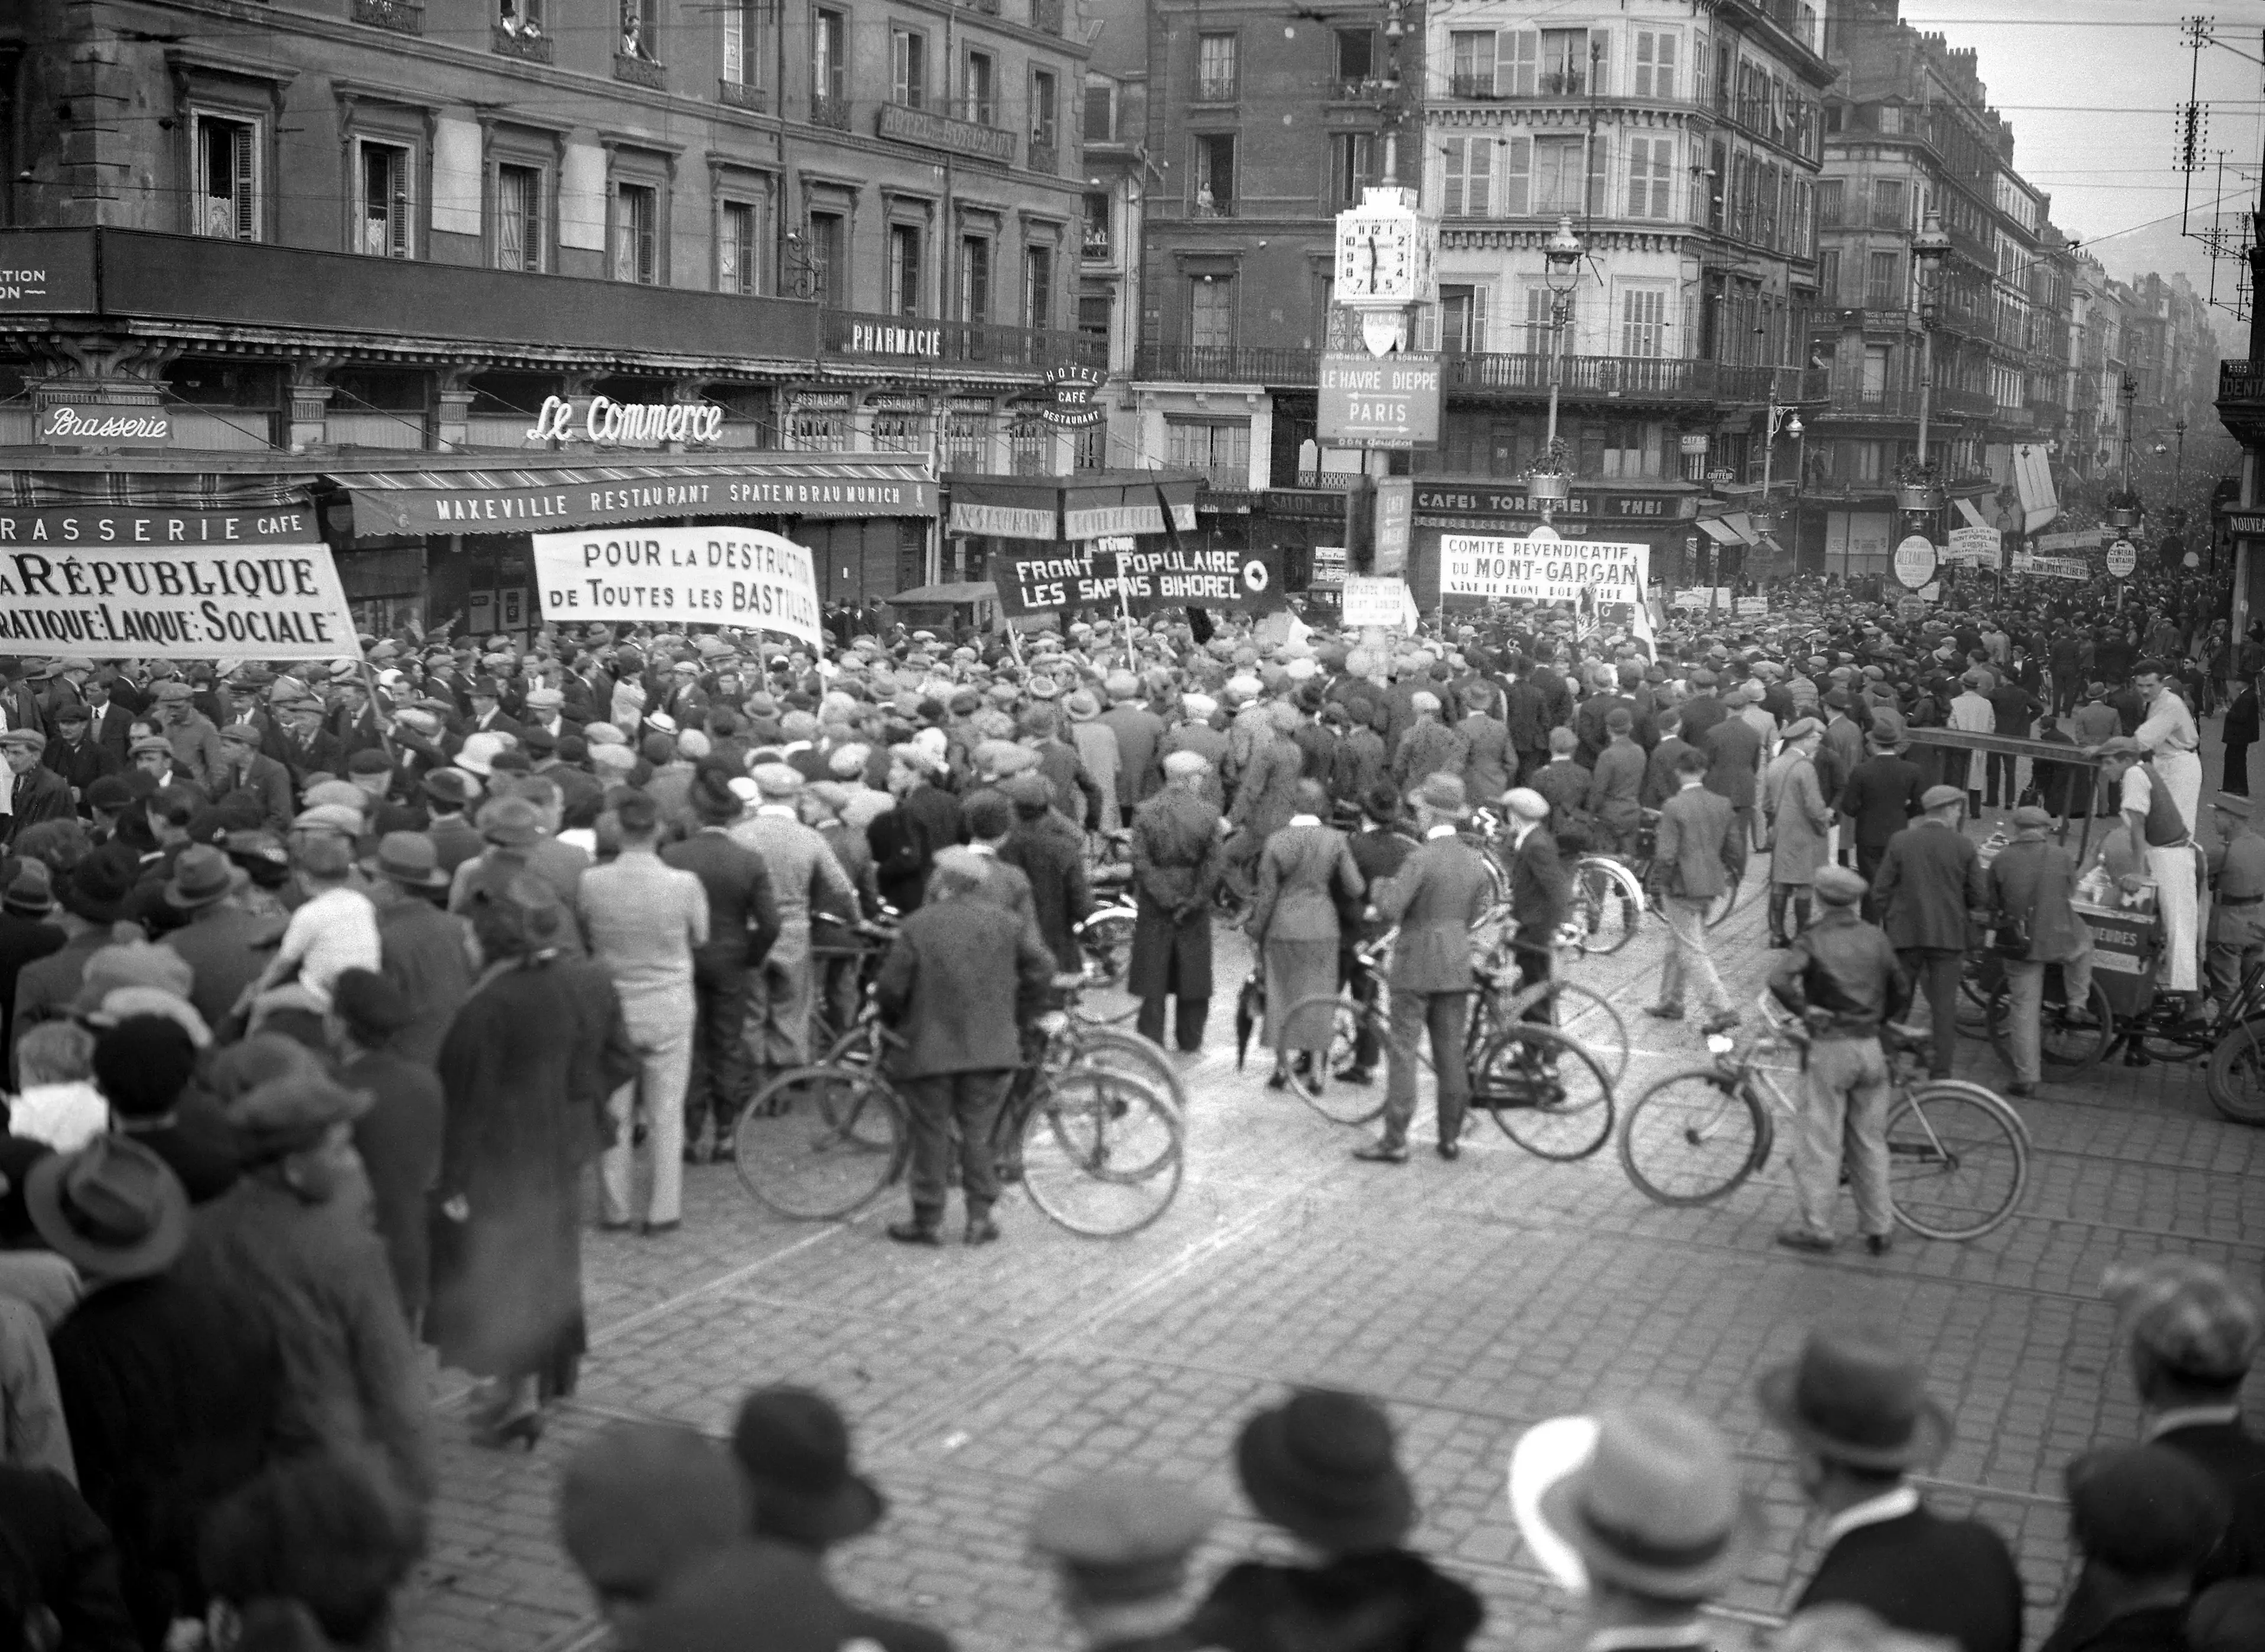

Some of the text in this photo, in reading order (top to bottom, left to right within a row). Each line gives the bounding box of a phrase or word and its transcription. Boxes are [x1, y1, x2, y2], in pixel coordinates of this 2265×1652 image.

[1359, 225, 1392, 235] 11 12 1
[1346, 236, 1404, 246] 10 2
[1347, 252, 1404, 262] 9 3
[0, 270, 45, 282] TION
[1346, 268, 1353, 278] 8
[1396, 268, 1402, 278] 4
[1356, 279, 1363, 289] 7
[1385, 279, 1392, 289] 5
[852, 325, 941, 355] PHARMACIE
[1046, 367, 1098, 383] HOTEL
[1322, 370, 1438, 390] LE HAVRE DIEPPE
[798, 392, 849, 408] RESTAURANT
[1058, 389, 1086, 403] CAFÉ
[527, 395, 723, 441] Le Commerce
[1043, 409, 1099, 425] RESTAURANT
[1349, 402, 1406, 422] PARIS
[44, 408, 168, 438] Brasserie
[436, 495, 567, 520] MAXEVILLE
[591, 485, 710, 511] RESTAURANT
[847, 485, 899, 504] MUNICH
[1418, 493, 1662, 514] CAFES TORRFIES THES
[0, 514, 302, 542] RASSERIE CAFE
[583, 540, 660, 568] POUR
[672, 548, 698, 568] LA
[1514, 542, 1629, 561] REVENDICATIF
[2108, 556, 2134, 565] DENTAIRE
[1016, 550, 1240, 583] FRONT POPULAIRE
[1453, 562, 1469, 574] DU
[550, 588, 578, 608] DE
[585, 579, 675, 608] TOUTES
[688, 588, 723, 610] LES
[1021, 582, 1066, 608] LES
[1160, 575, 1241, 599] BIHOREL
